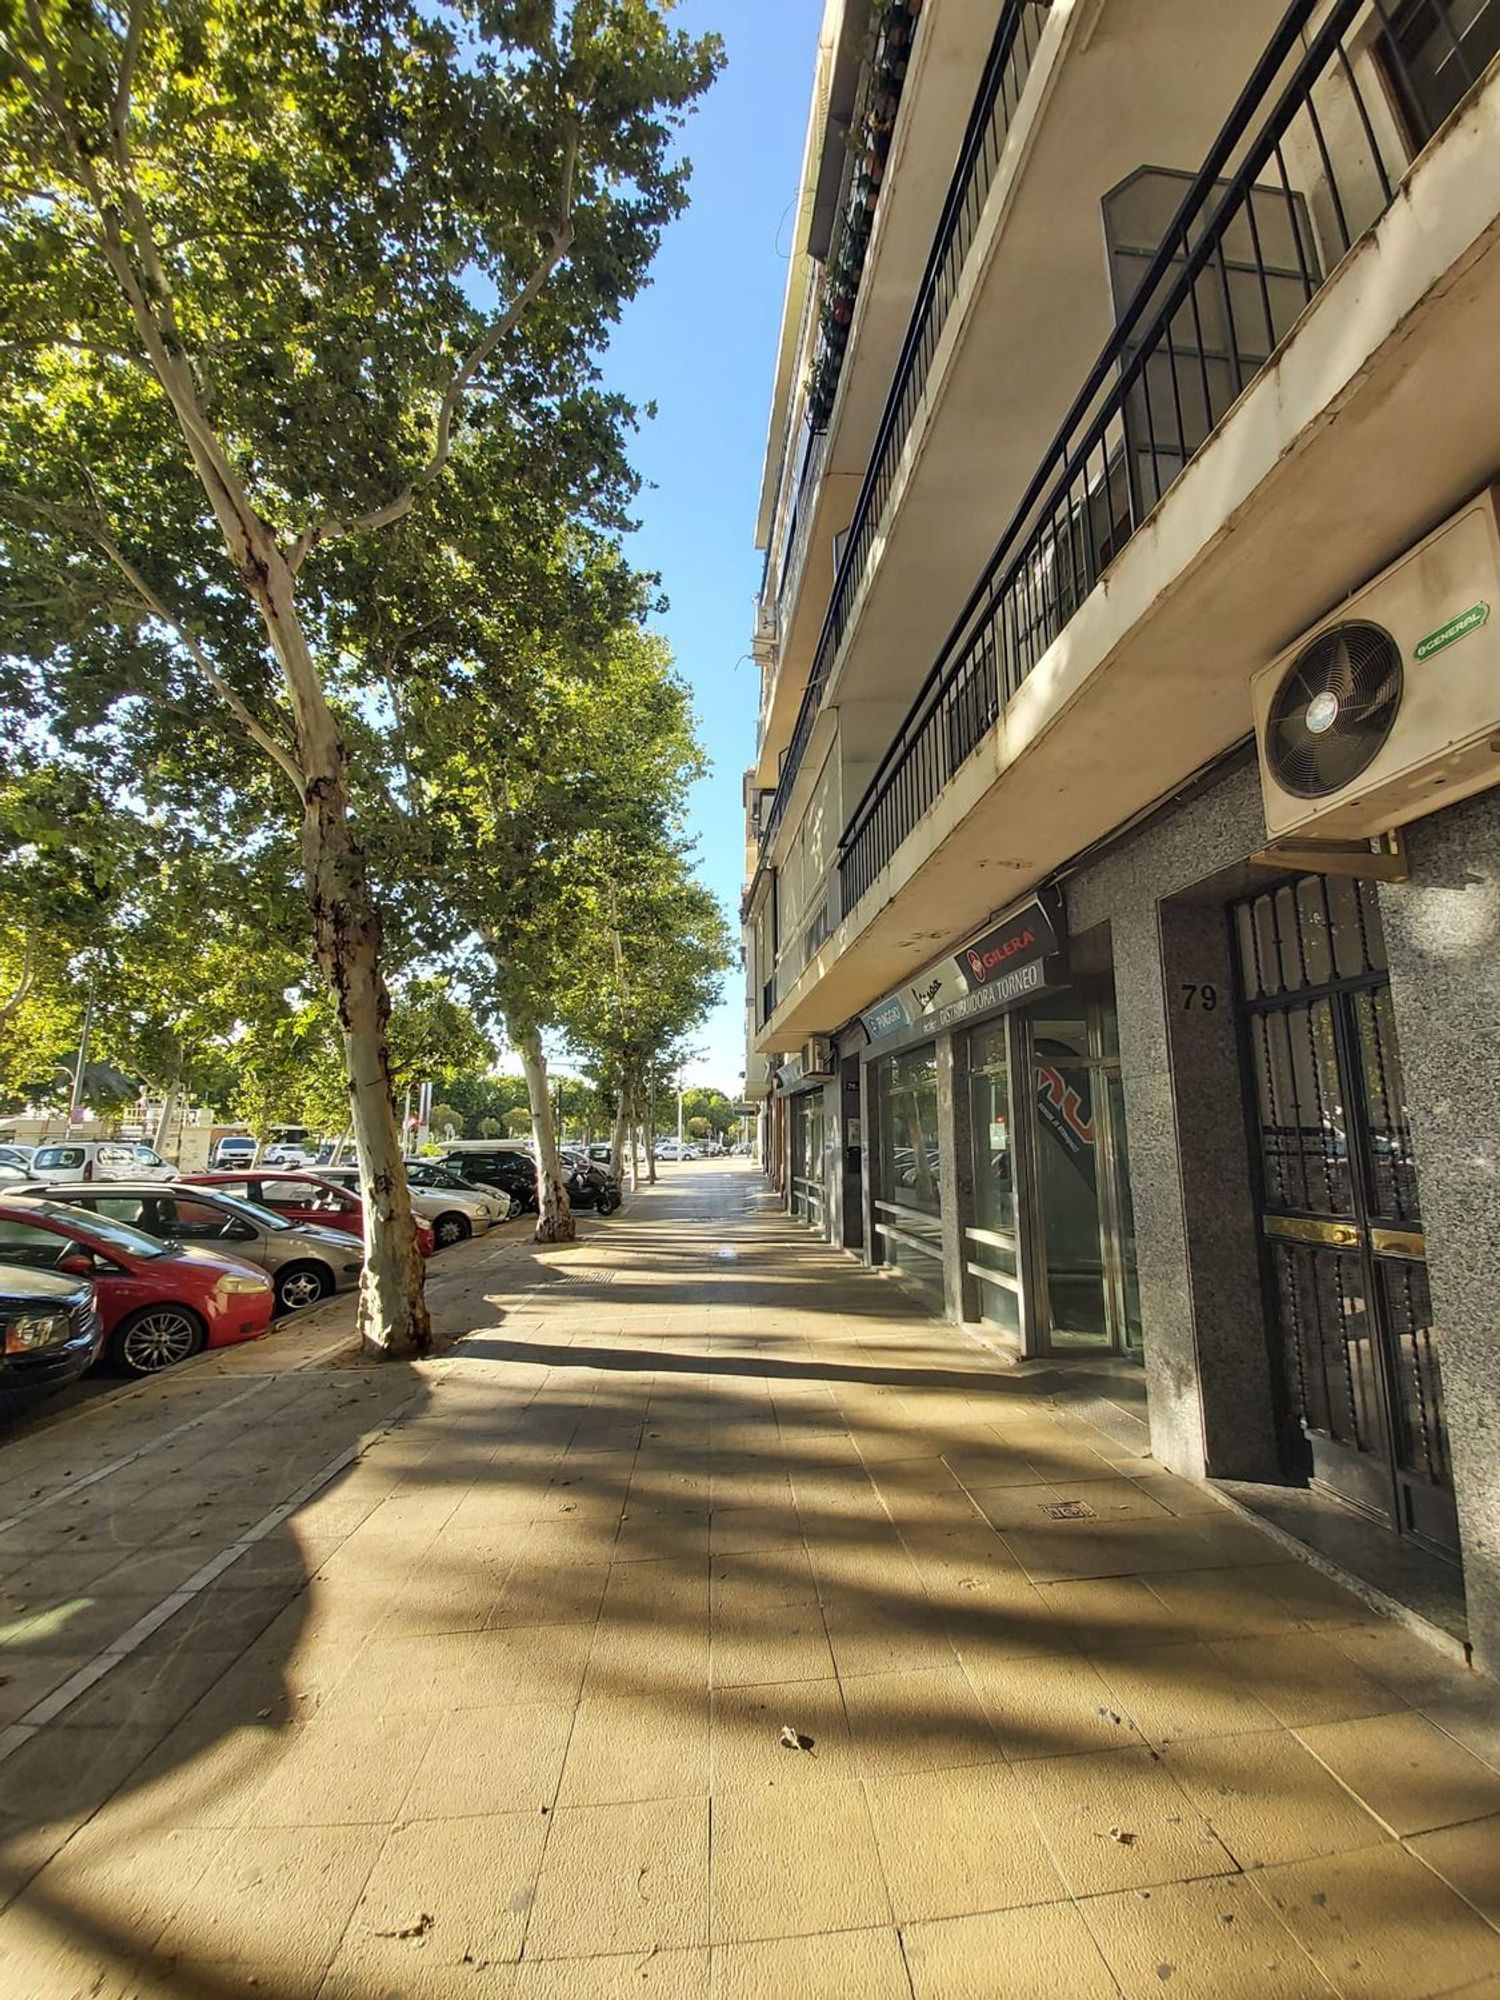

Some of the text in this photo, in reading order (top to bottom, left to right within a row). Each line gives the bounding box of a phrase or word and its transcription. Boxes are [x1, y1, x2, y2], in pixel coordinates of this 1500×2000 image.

[1426, 613, 1480, 650] GENERAL
[982, 929, 1035, 967] GILERA
[939, 966, 1038, 1024] DISTRIBUIDORA TORNEO
[1181, 984, 1217, 1011] 79
[876, 1006, 901, 1029] PIAGGIO
